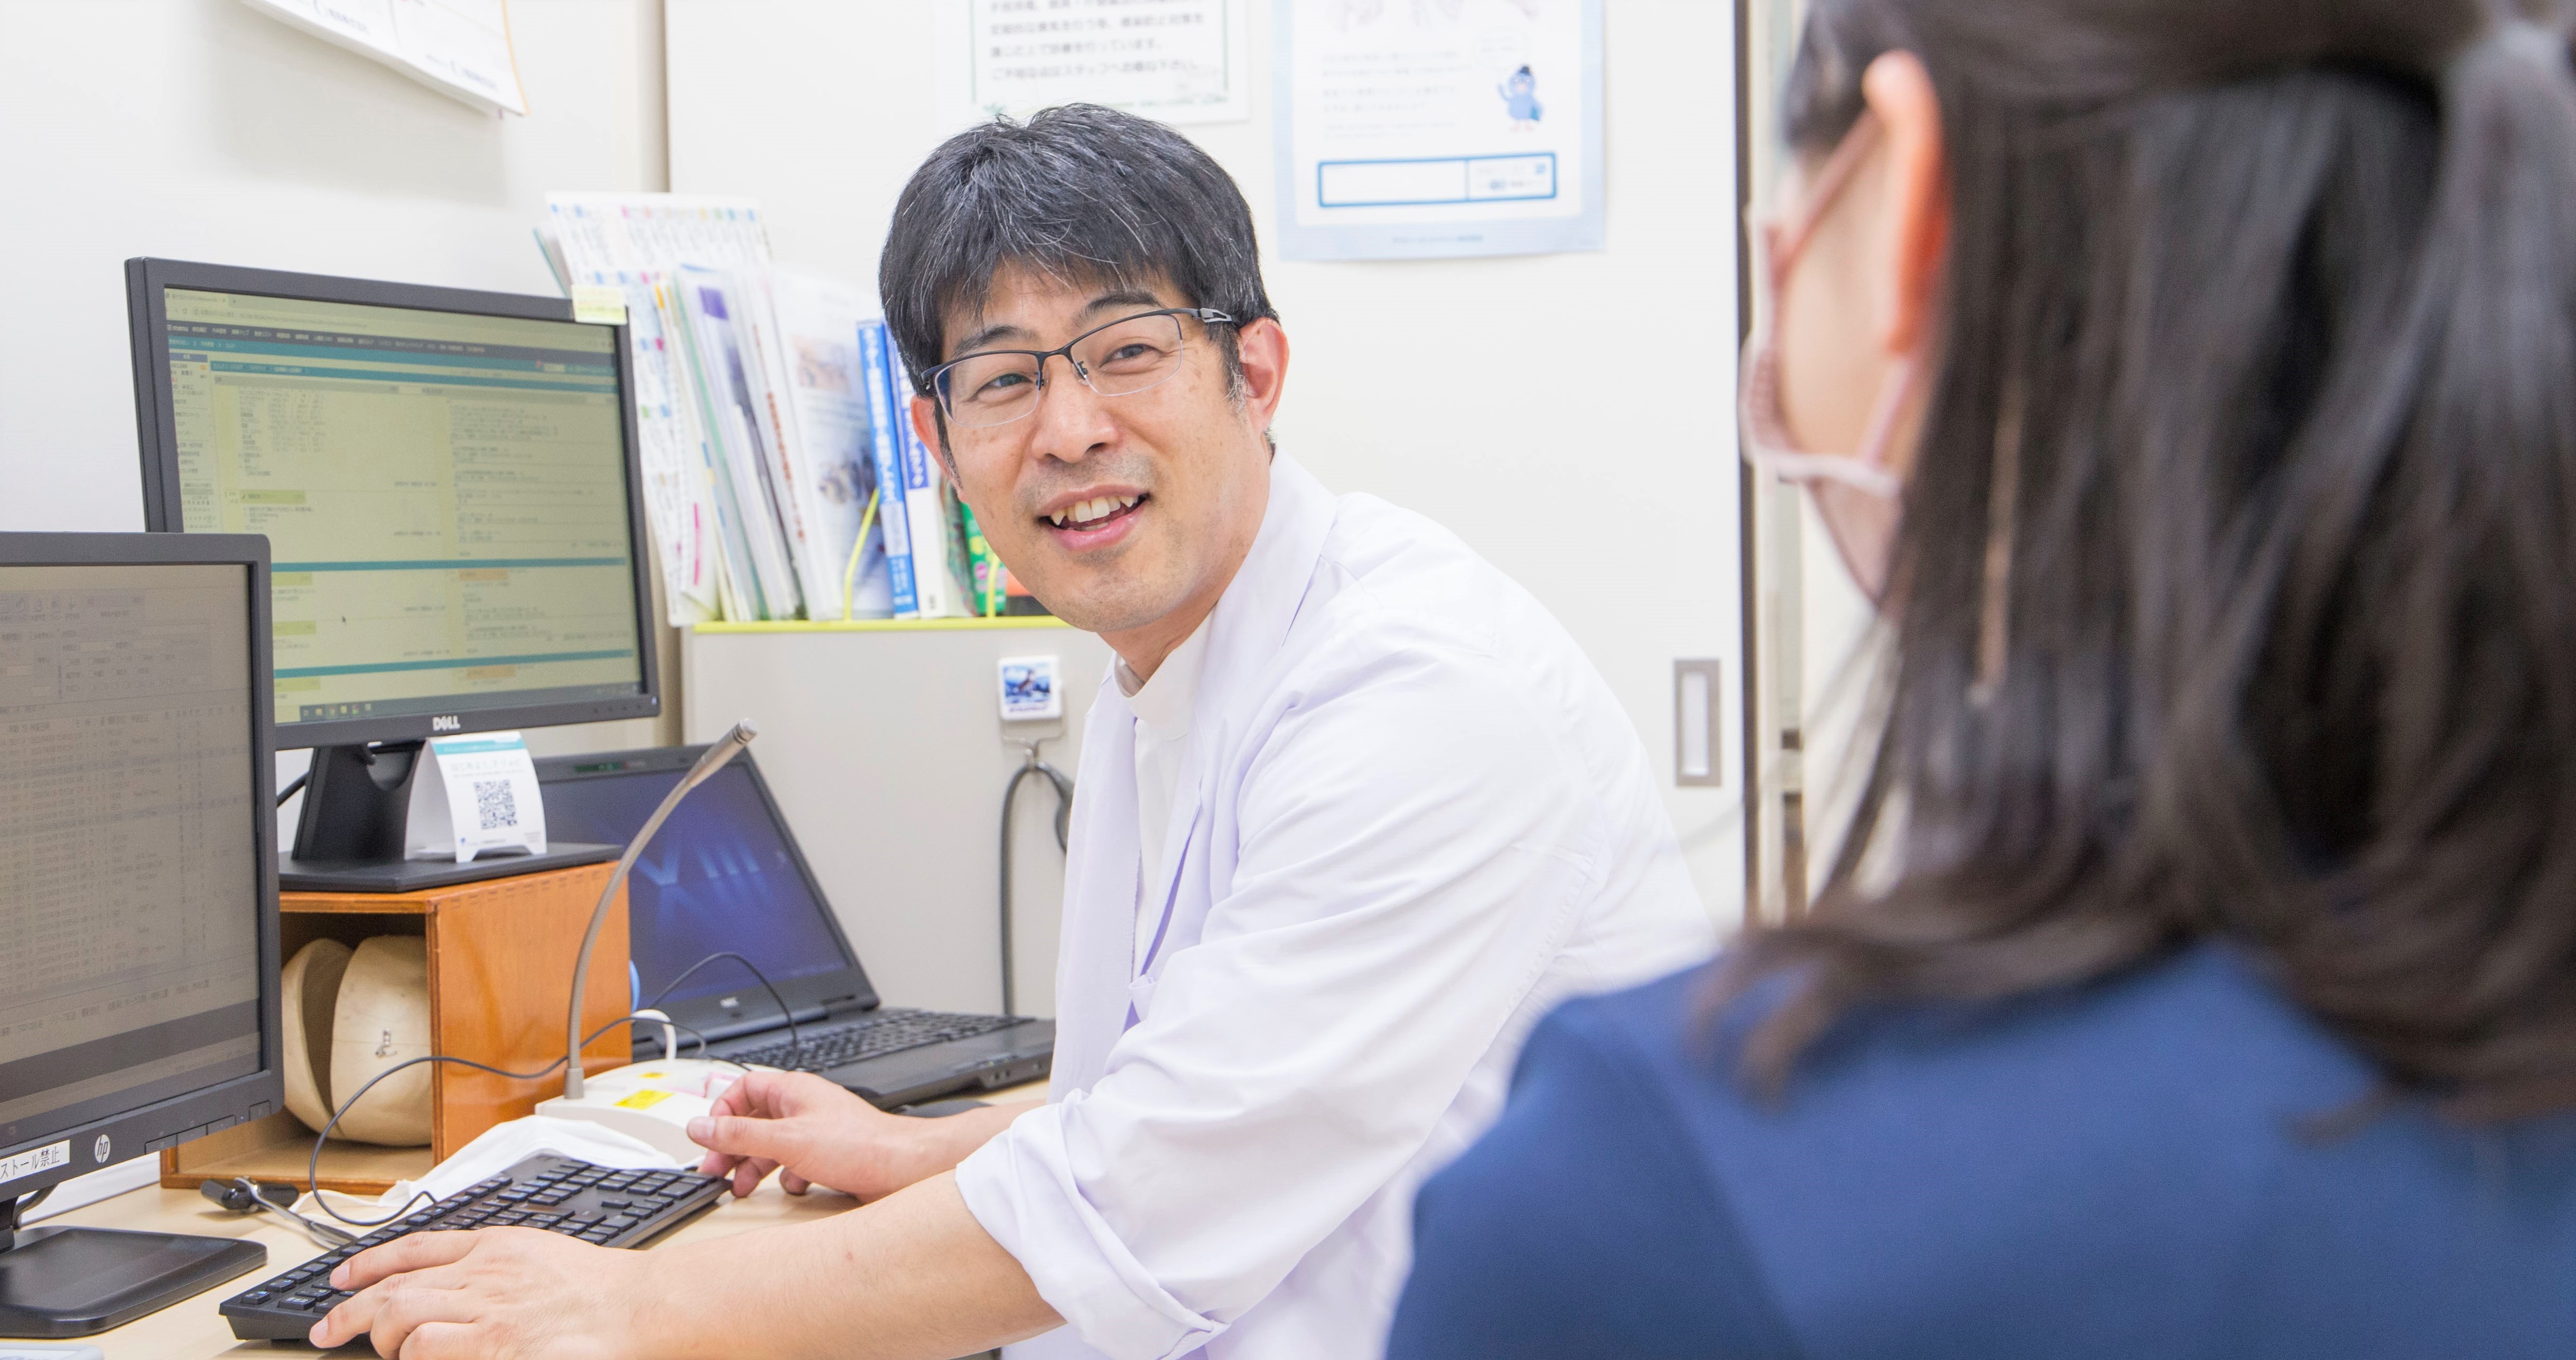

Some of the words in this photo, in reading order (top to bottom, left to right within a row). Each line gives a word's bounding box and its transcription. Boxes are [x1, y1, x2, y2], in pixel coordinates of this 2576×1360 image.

[433, 716, 460, 730] DELL
[1, 1146, 60, 1179] ストール禁止
[96, 1135, 109, 1163] hp
